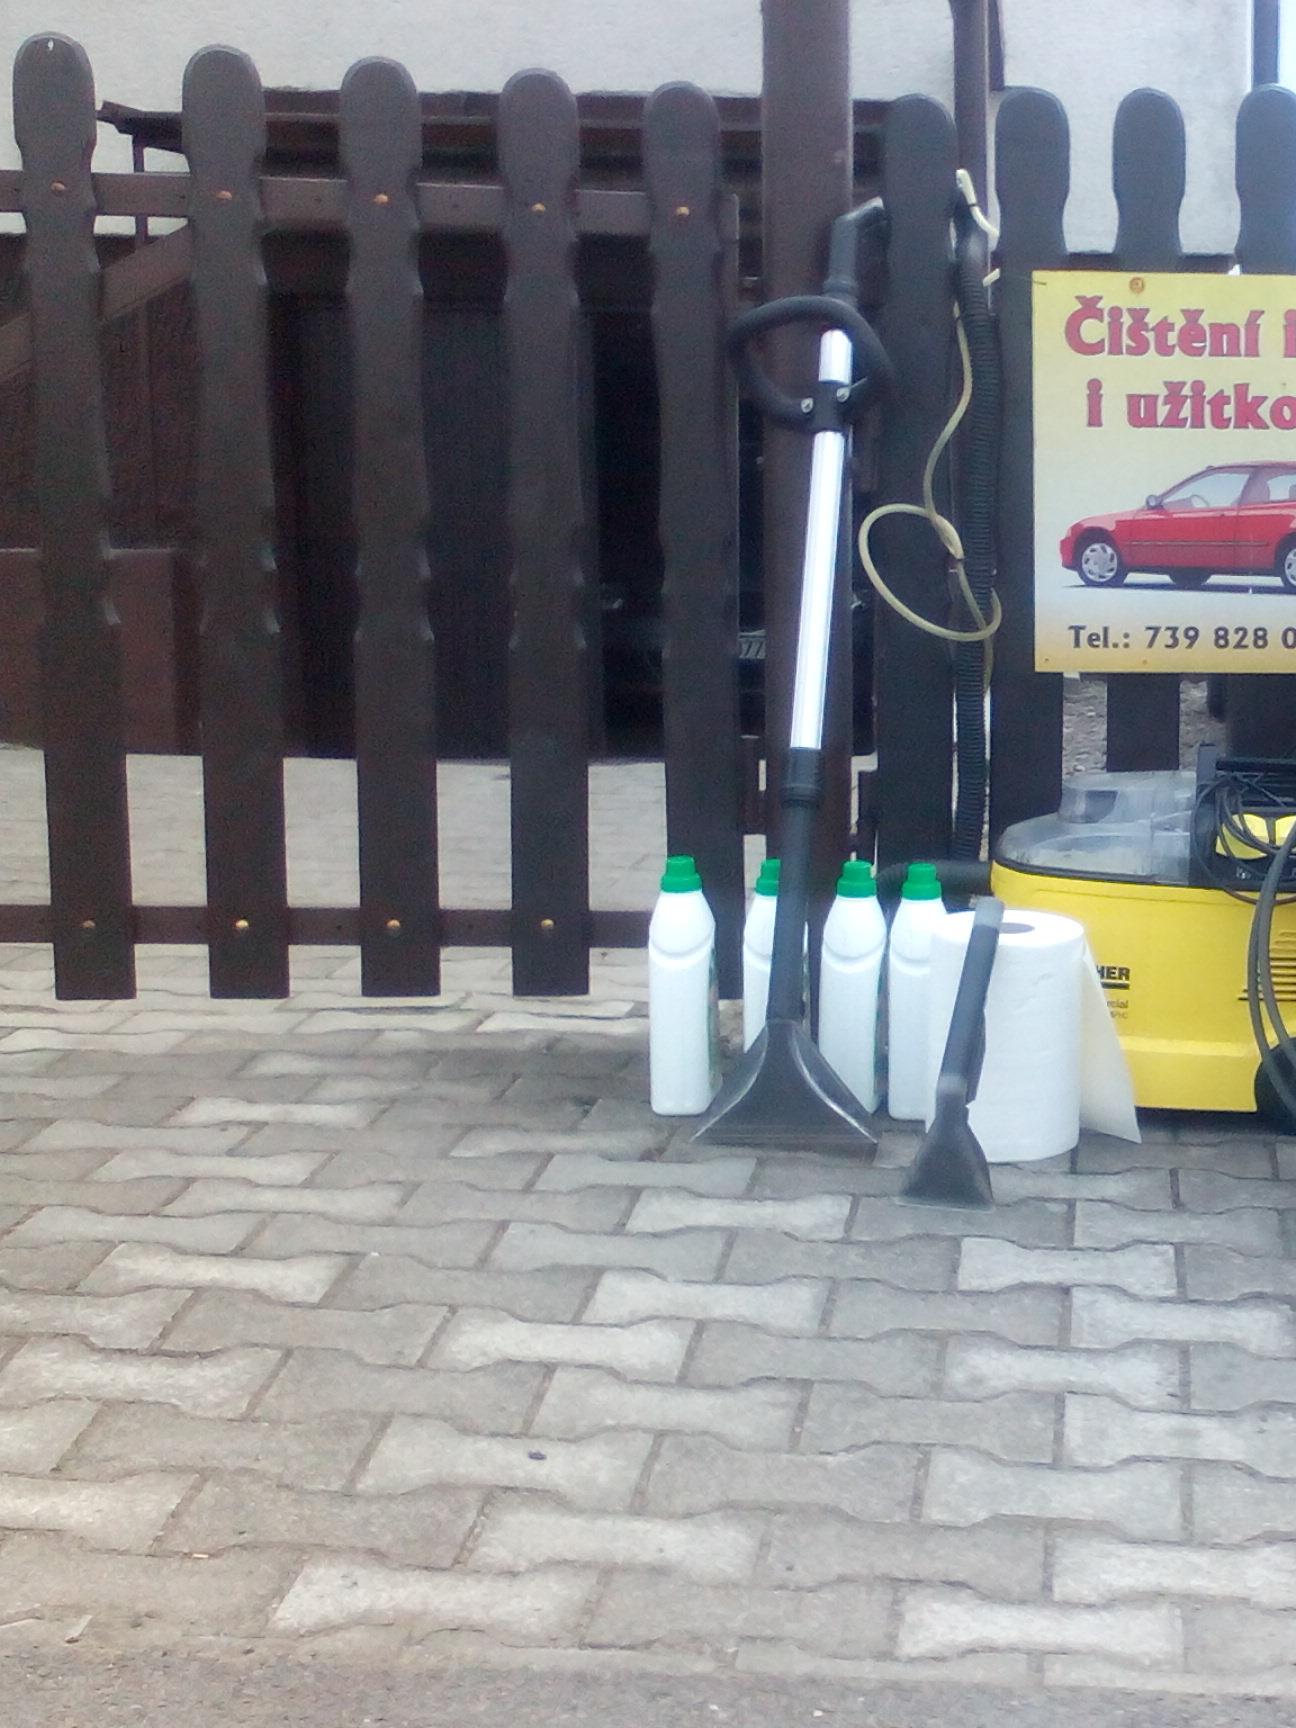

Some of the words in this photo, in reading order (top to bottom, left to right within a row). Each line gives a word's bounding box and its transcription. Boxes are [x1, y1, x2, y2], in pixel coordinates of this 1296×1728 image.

[1064, 295, 1265, 357] Čištění
[1086, 378, 1104, 428] i
[1068, 625, 1132, 650] Tel.:
[1144, 626, 1200, 650] 739
[1213, 626, 1269, 650] 828
